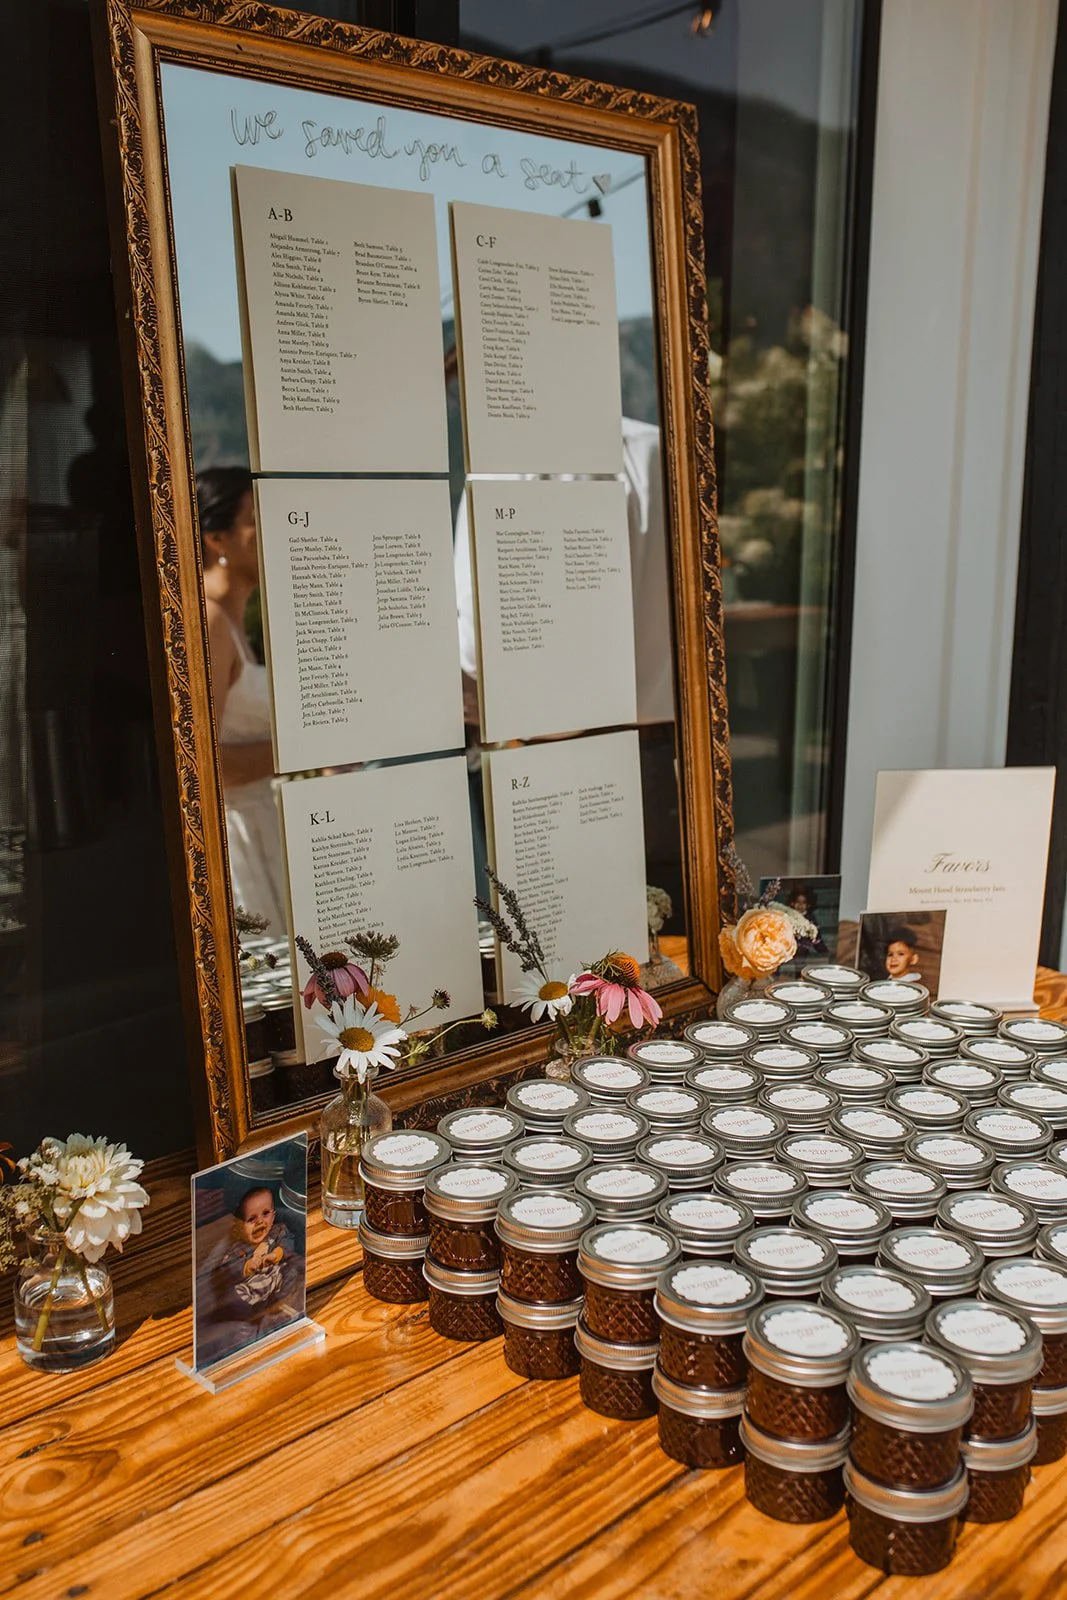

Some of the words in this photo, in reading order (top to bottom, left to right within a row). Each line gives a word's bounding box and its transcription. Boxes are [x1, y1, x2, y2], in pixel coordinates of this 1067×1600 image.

[301, 115, 399, 159] saved
[404, 138, 466, 182] you
[482, 152, 508, 178] a
[520, 157, 587, 194] seat
[268, 208, 293, 221] A-B
[311, 237, 325, 245] Table
[476, 235, 496, 248] C-F
[286, 263, 301, 271] Smith,
[303, 264, 316, 272] Table
[307, 293, 320, 301] Table
[291, 329, 307, 337] Miller,
[308, 330, 321, 338] Table
[297, 367, 312, 375] Smith,
[496, 508, 515, 519] M-P
[288, 511, 309, 528] G-J
[511, 776, 530, 790] R-Z
[310, 811, 335, 825] K-L
[924, 852, 991, 873] Favors
[346, 865, 358, 873] Table
[955, 885, 990, 893] Strawberry
[346, 891, 359, 899] Table
